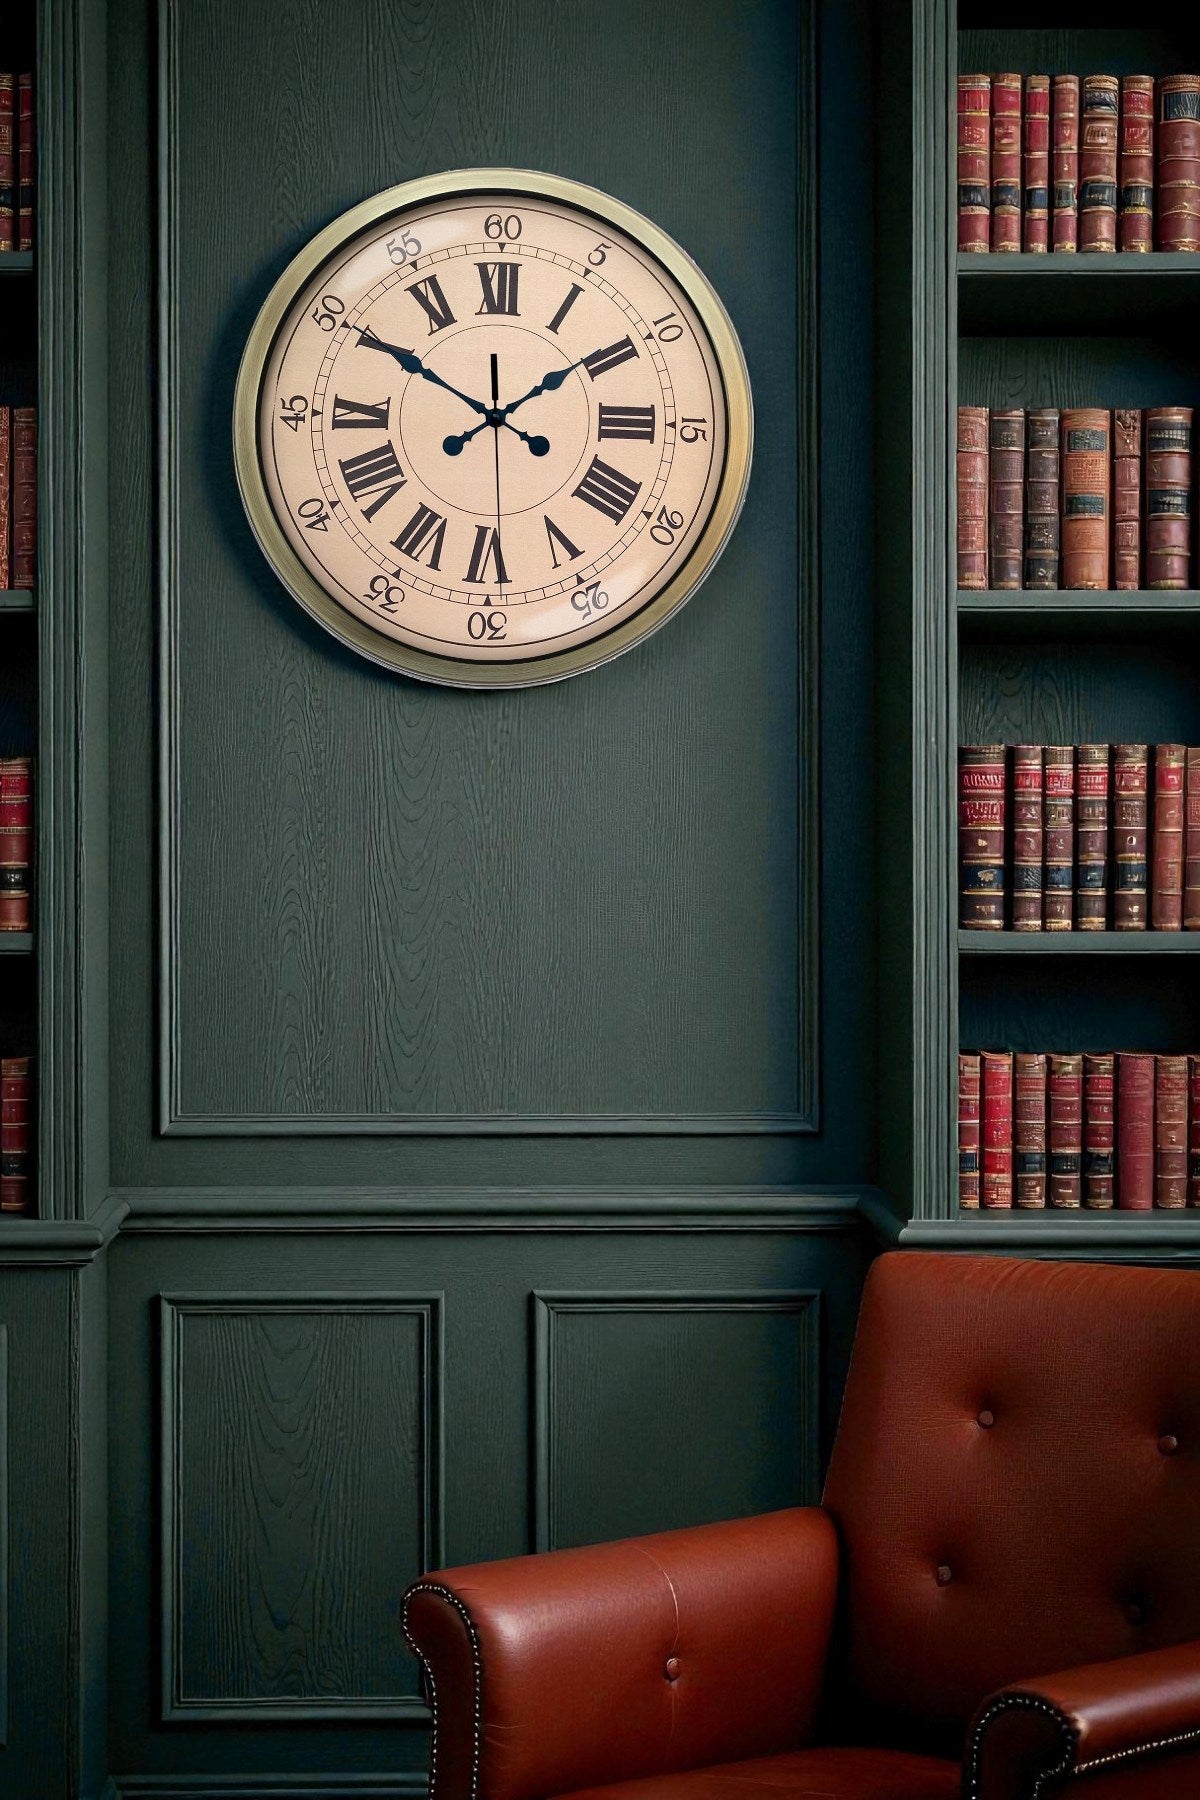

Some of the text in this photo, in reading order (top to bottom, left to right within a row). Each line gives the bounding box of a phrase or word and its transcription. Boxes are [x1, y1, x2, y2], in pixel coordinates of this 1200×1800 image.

[484, 214, 522, 240] 60
[386, 230, 421, 265] 55
[588, 243, 612, 266] 5
[404, 273, 458, 336] XI
[474, 262, 522, 316] XII
[546, 282, 585, 335] I
[311, 293, 346, 333] 50
[651, 310, 684, 344] 10
[579, 334, 640, 382] II
[279, 395, 308, 432] 45
[332, 394, 391, 430] IX
[598, 402, 655, 444] III
[680, 417, 707, 443] 15
[337, 439, 408, 525] VIII
[570, 453, 643, 525] IIII
[297, 496, 330, 533] 40
[650, 508, 685, 547] 20
[389, 502, 448, 572] VII
[462, 524, 512, 584] VI
[544, 515, 585, 570] V
[363, 574, 407, 613] 35
[570, 580, 609, 619] 25
[468, 612, 507, 640] 30
